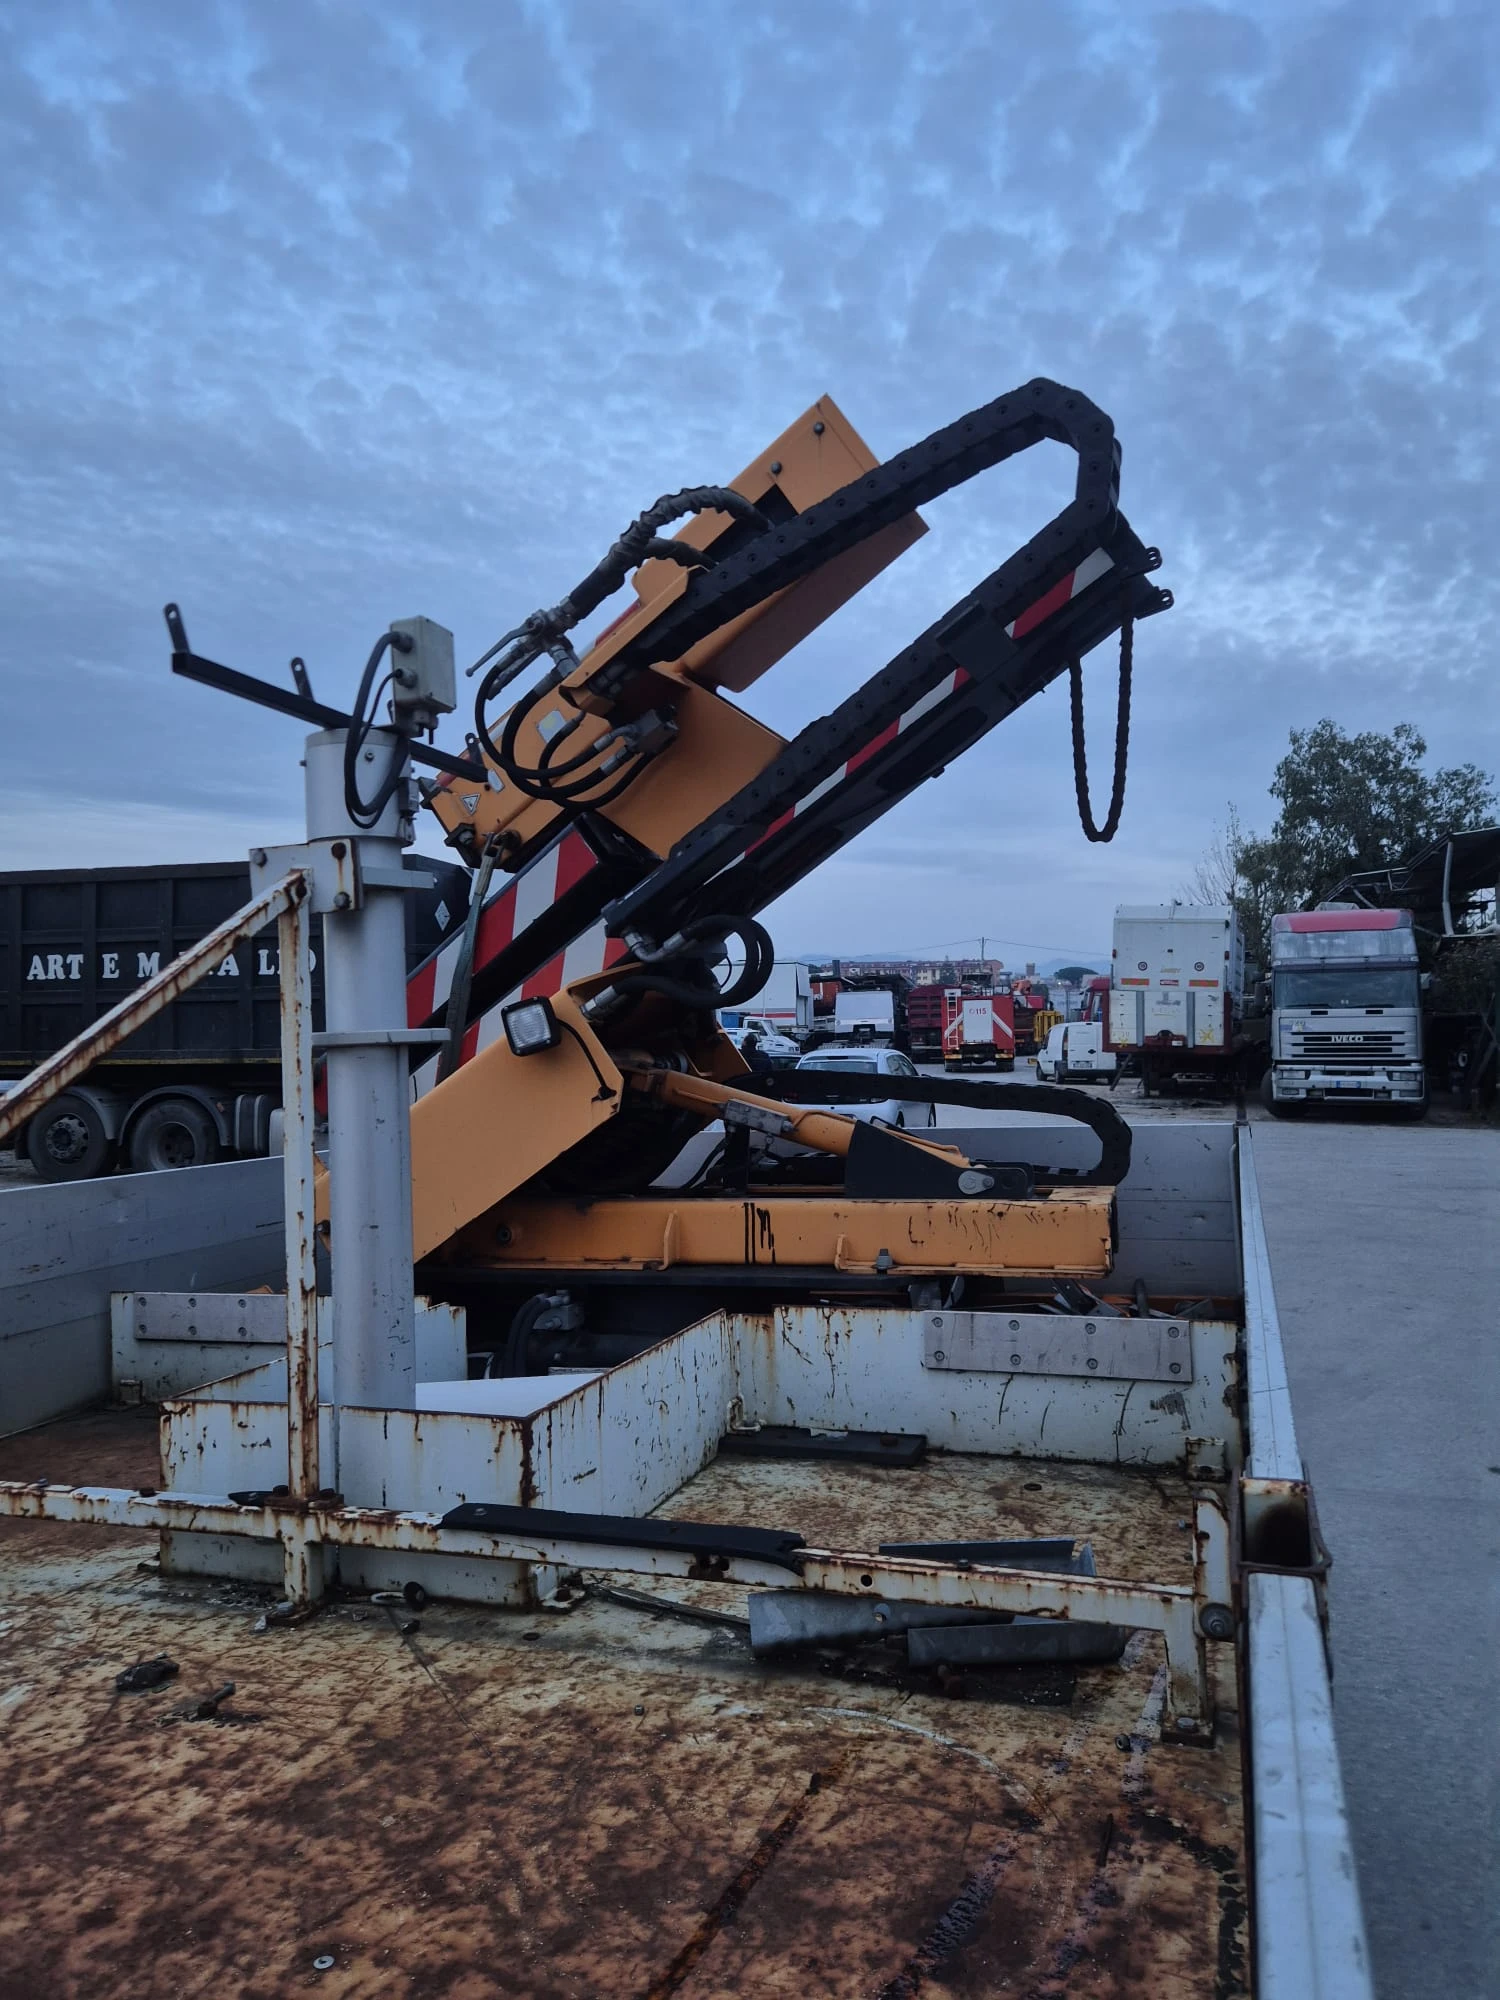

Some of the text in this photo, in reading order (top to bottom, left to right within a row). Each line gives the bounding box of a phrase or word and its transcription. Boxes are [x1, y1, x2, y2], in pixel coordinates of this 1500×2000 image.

[26, 954, 84, 981] ART
[102, 953, 120, 979] E
[1331, 1035, 1364, 1043] IVECO
